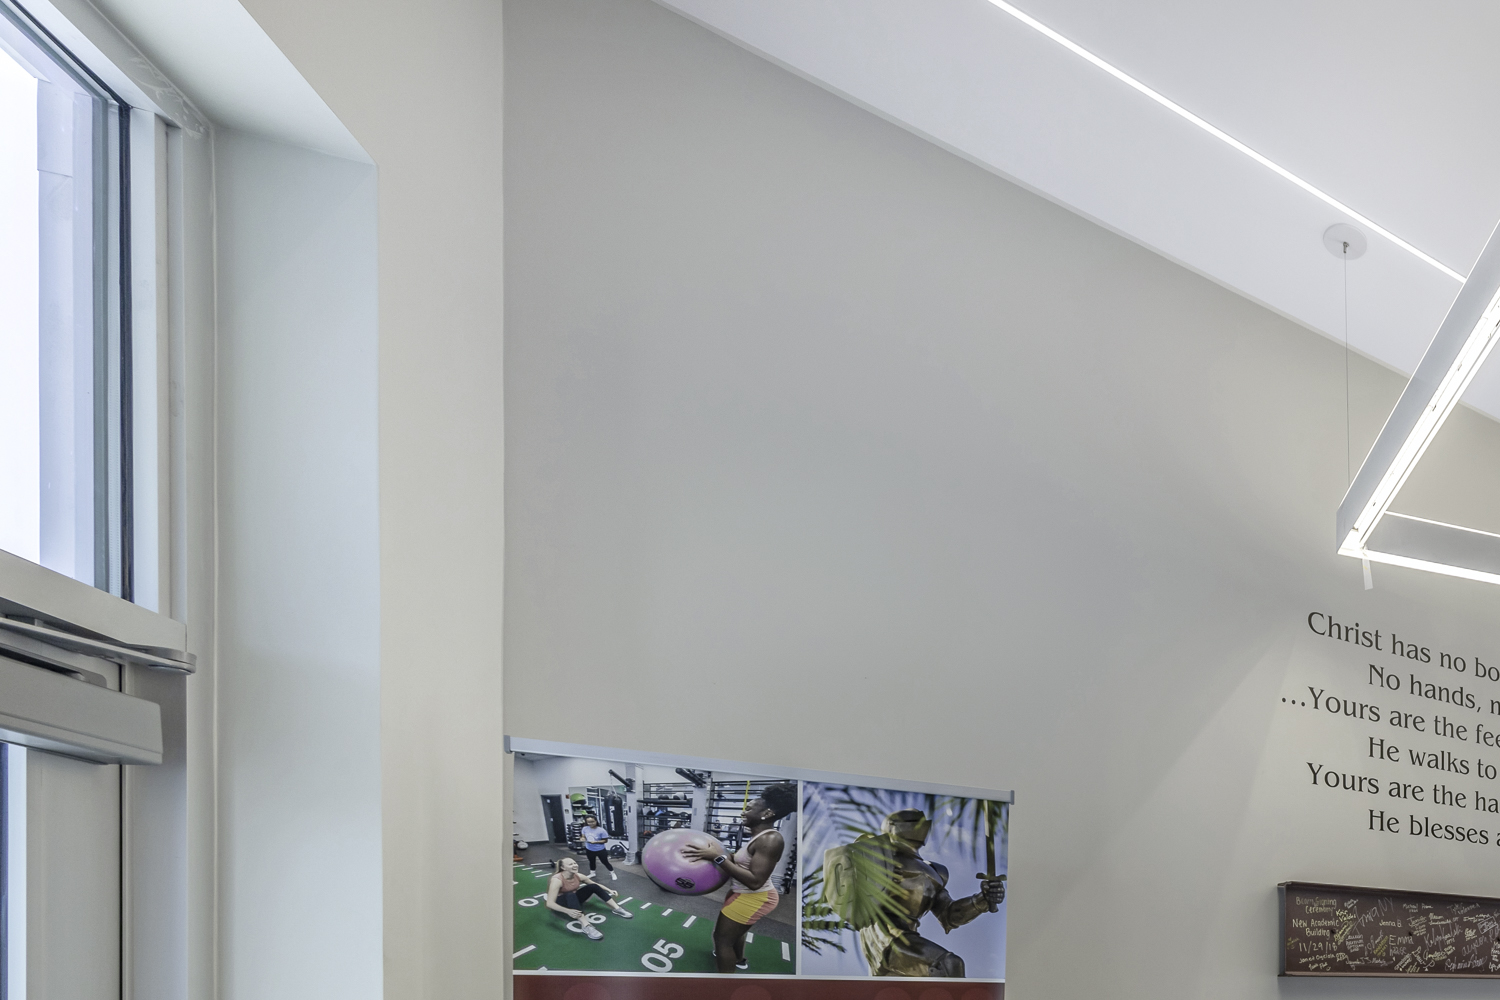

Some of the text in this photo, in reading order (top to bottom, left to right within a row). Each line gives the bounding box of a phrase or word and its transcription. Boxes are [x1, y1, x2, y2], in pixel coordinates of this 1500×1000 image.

[1307, 611, 1383, 651] Christ
[1391, 633, 1431, 663] has
[1439, 651, 1467, 673] no
[1368, 663, 1401, 691] No
[1409, 673, 1481, 713] hands,
[1281, 685, 1381, 723] ...Yours
[1389, 709, 1426, 732] are
[1433, 715, 1468, 741] the
[1368, 736, 1401, 763] He
[1408, 749, 1470, 775] walks
[1477, 758, 1497, 780] to
[1306, 762, 1380, 795] Yours
[1388, 780, 1425, 802] are
[1432, 784, 1467, 809] the
[1368, 808, 1401, 834] He
[1408, 814, 1489, 845] blesses
[1292, 917, 1340, 928] New Academic
[1305, 927, 1331, 941] Building
[641, 939, 685, 974] 05
